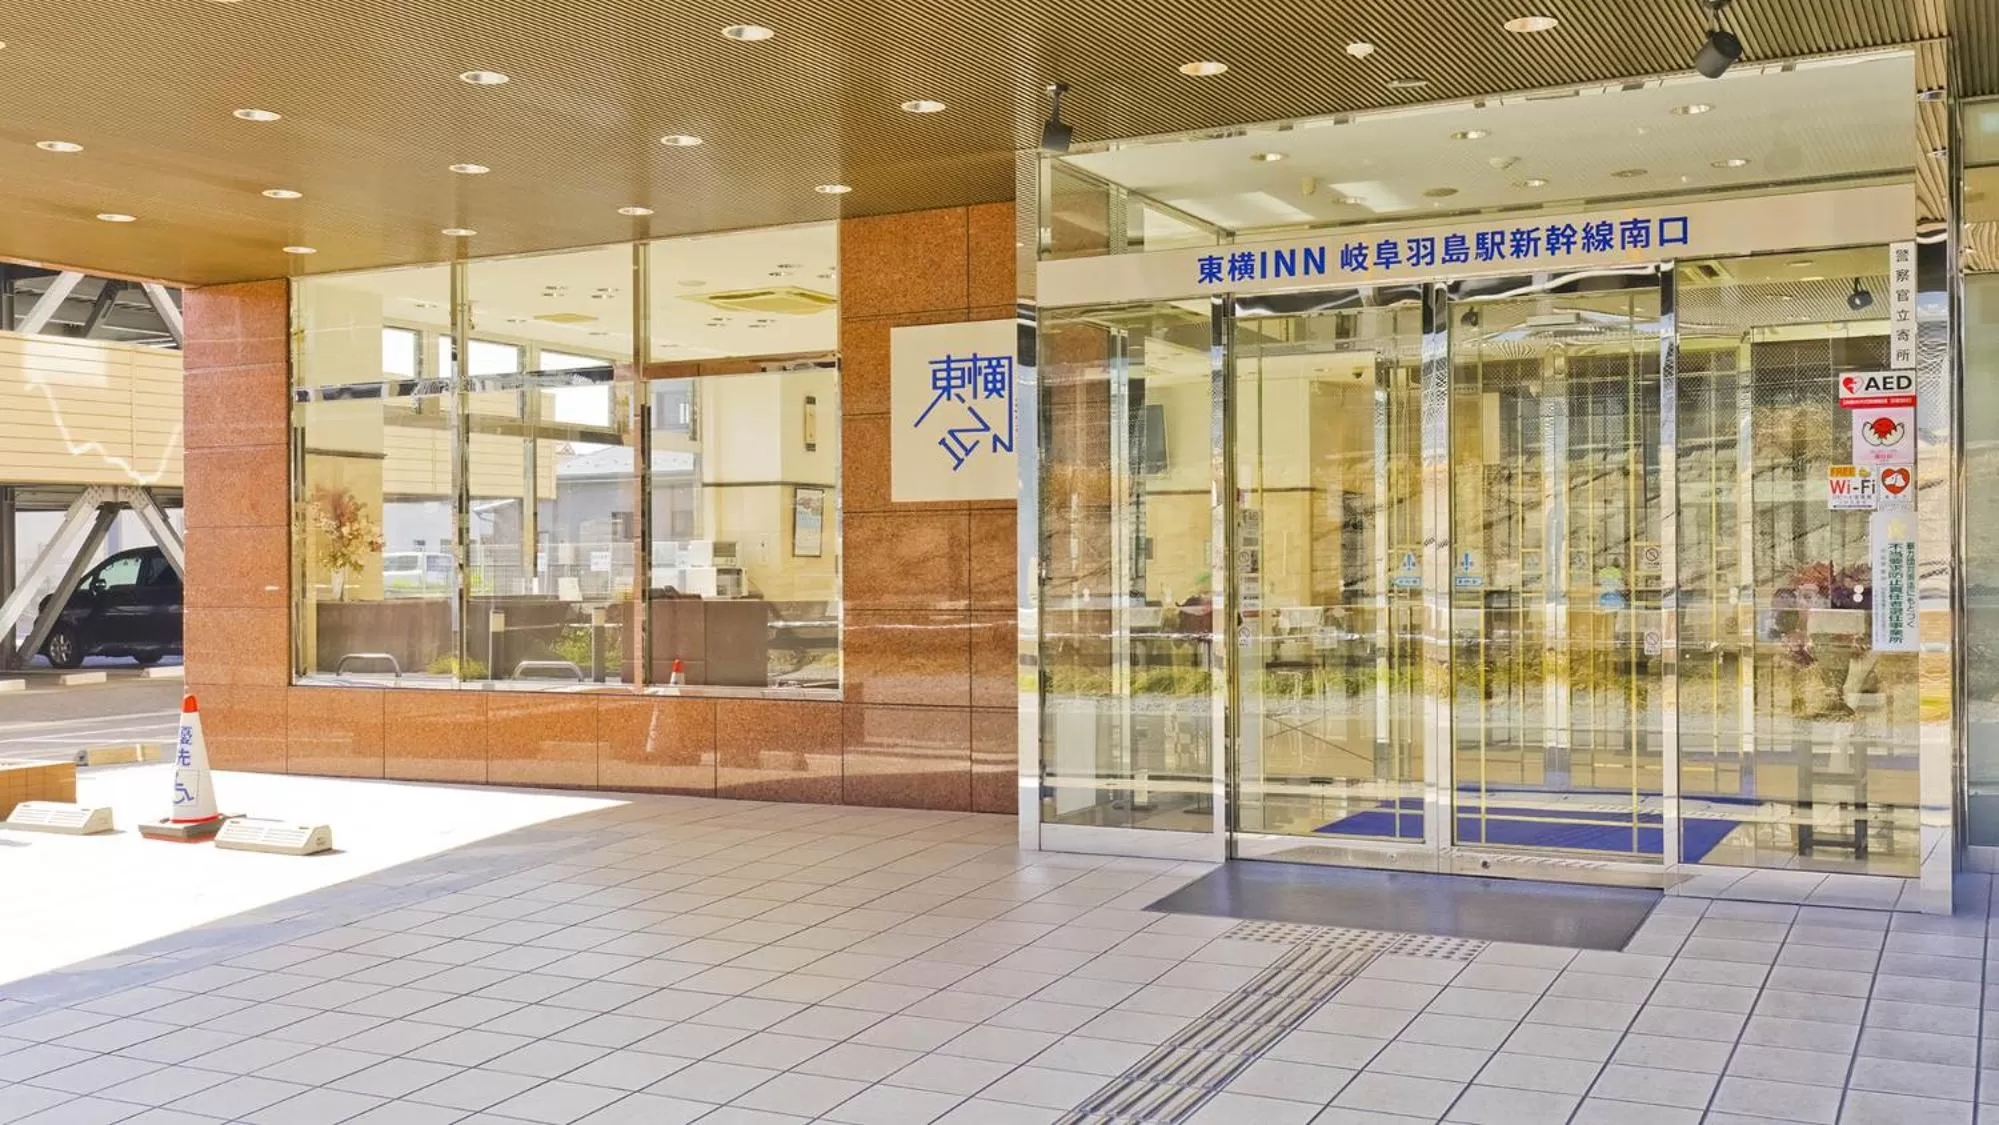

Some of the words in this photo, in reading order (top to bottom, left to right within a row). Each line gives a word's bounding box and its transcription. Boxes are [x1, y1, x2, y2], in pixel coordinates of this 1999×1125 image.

[1197, 245, 1327, 284] 東横INN
[1339, 215, 1690, 274] 岐阜羽島駅新幹線南口
[1895, 248, 1911, 362] 警察官立寄所
[1864, 375, 1912, 391] AED
[1830, 479, 1876, 495] Wi-Fi
